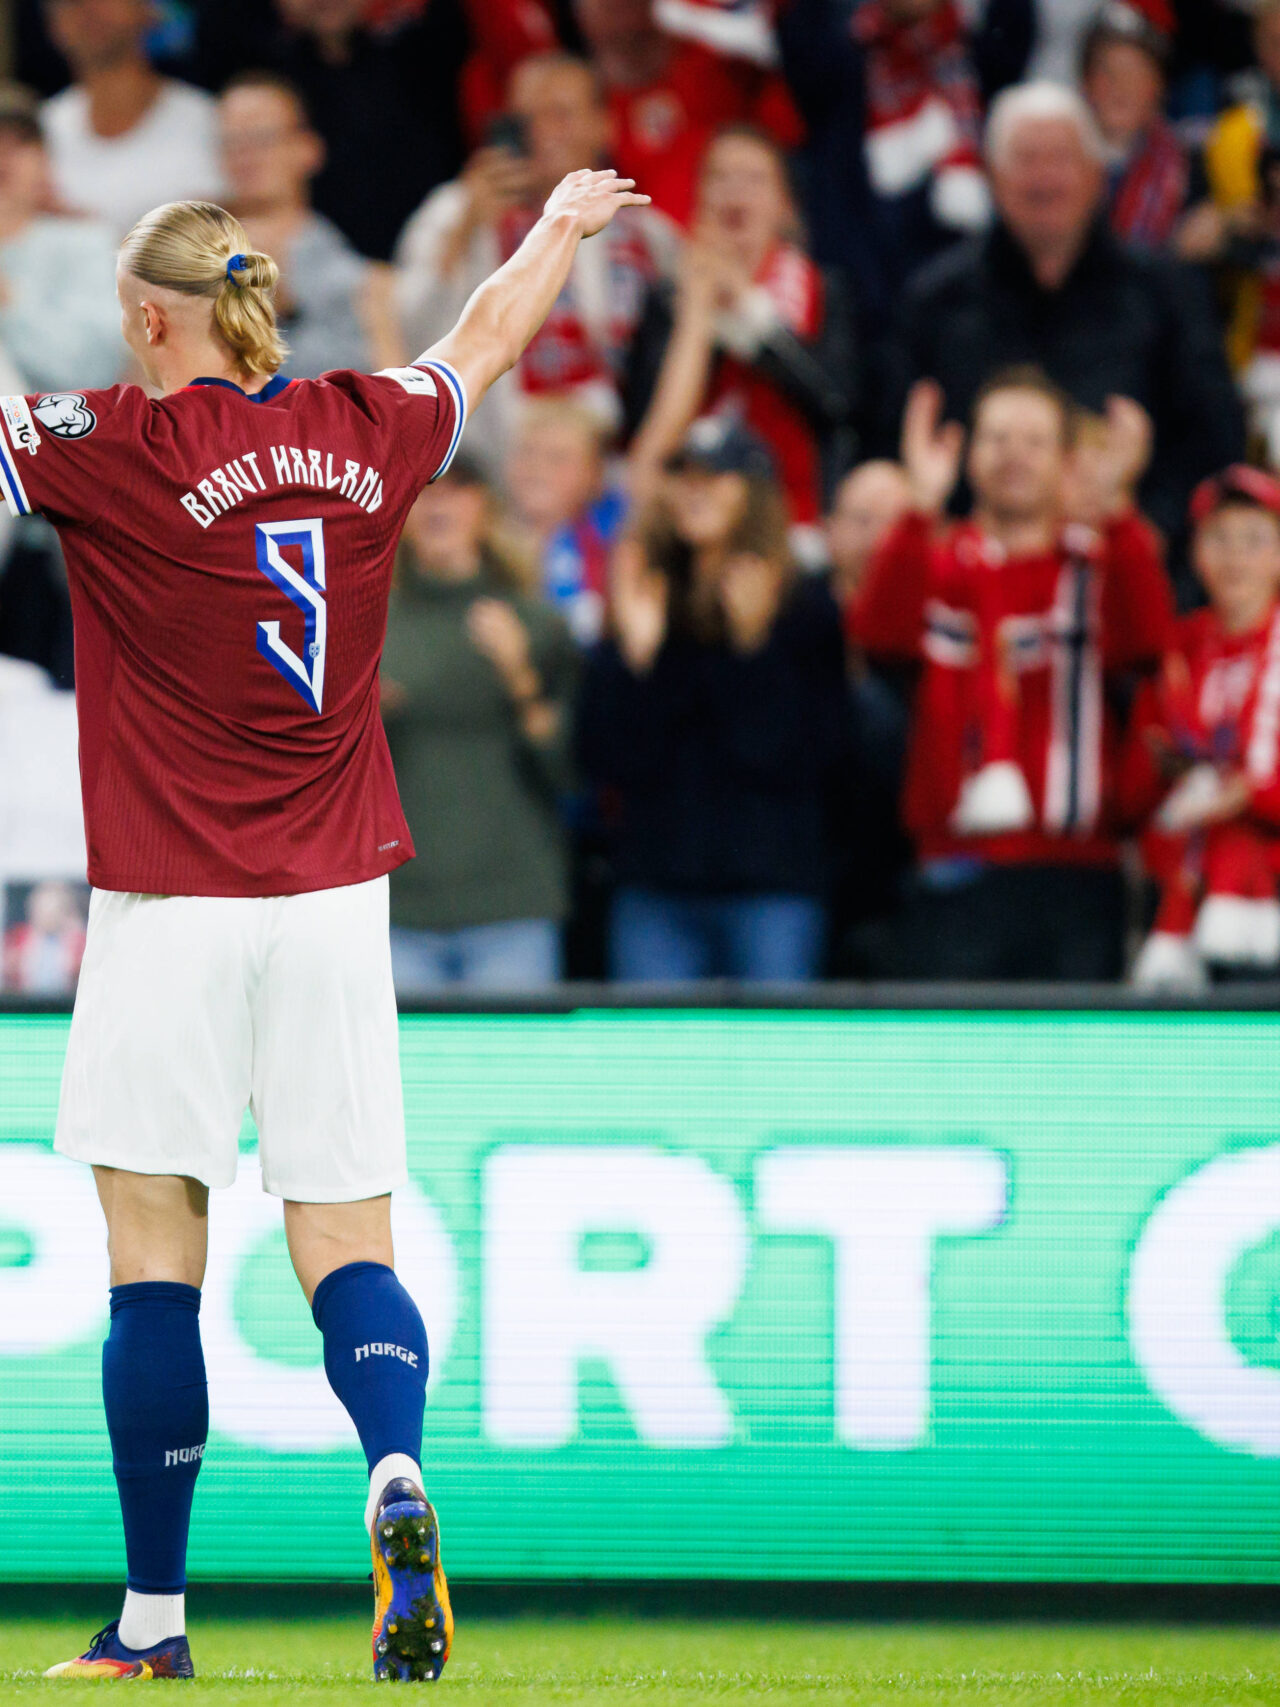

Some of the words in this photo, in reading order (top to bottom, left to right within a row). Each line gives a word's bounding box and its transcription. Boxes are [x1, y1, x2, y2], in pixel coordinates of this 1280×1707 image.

[179, 451, 267, 529] BRAUT
[269, 445, 383, 514] HAALAND
[255, 517, 327, 716] 9
[354, 1342, 419, 1369] NORGE
